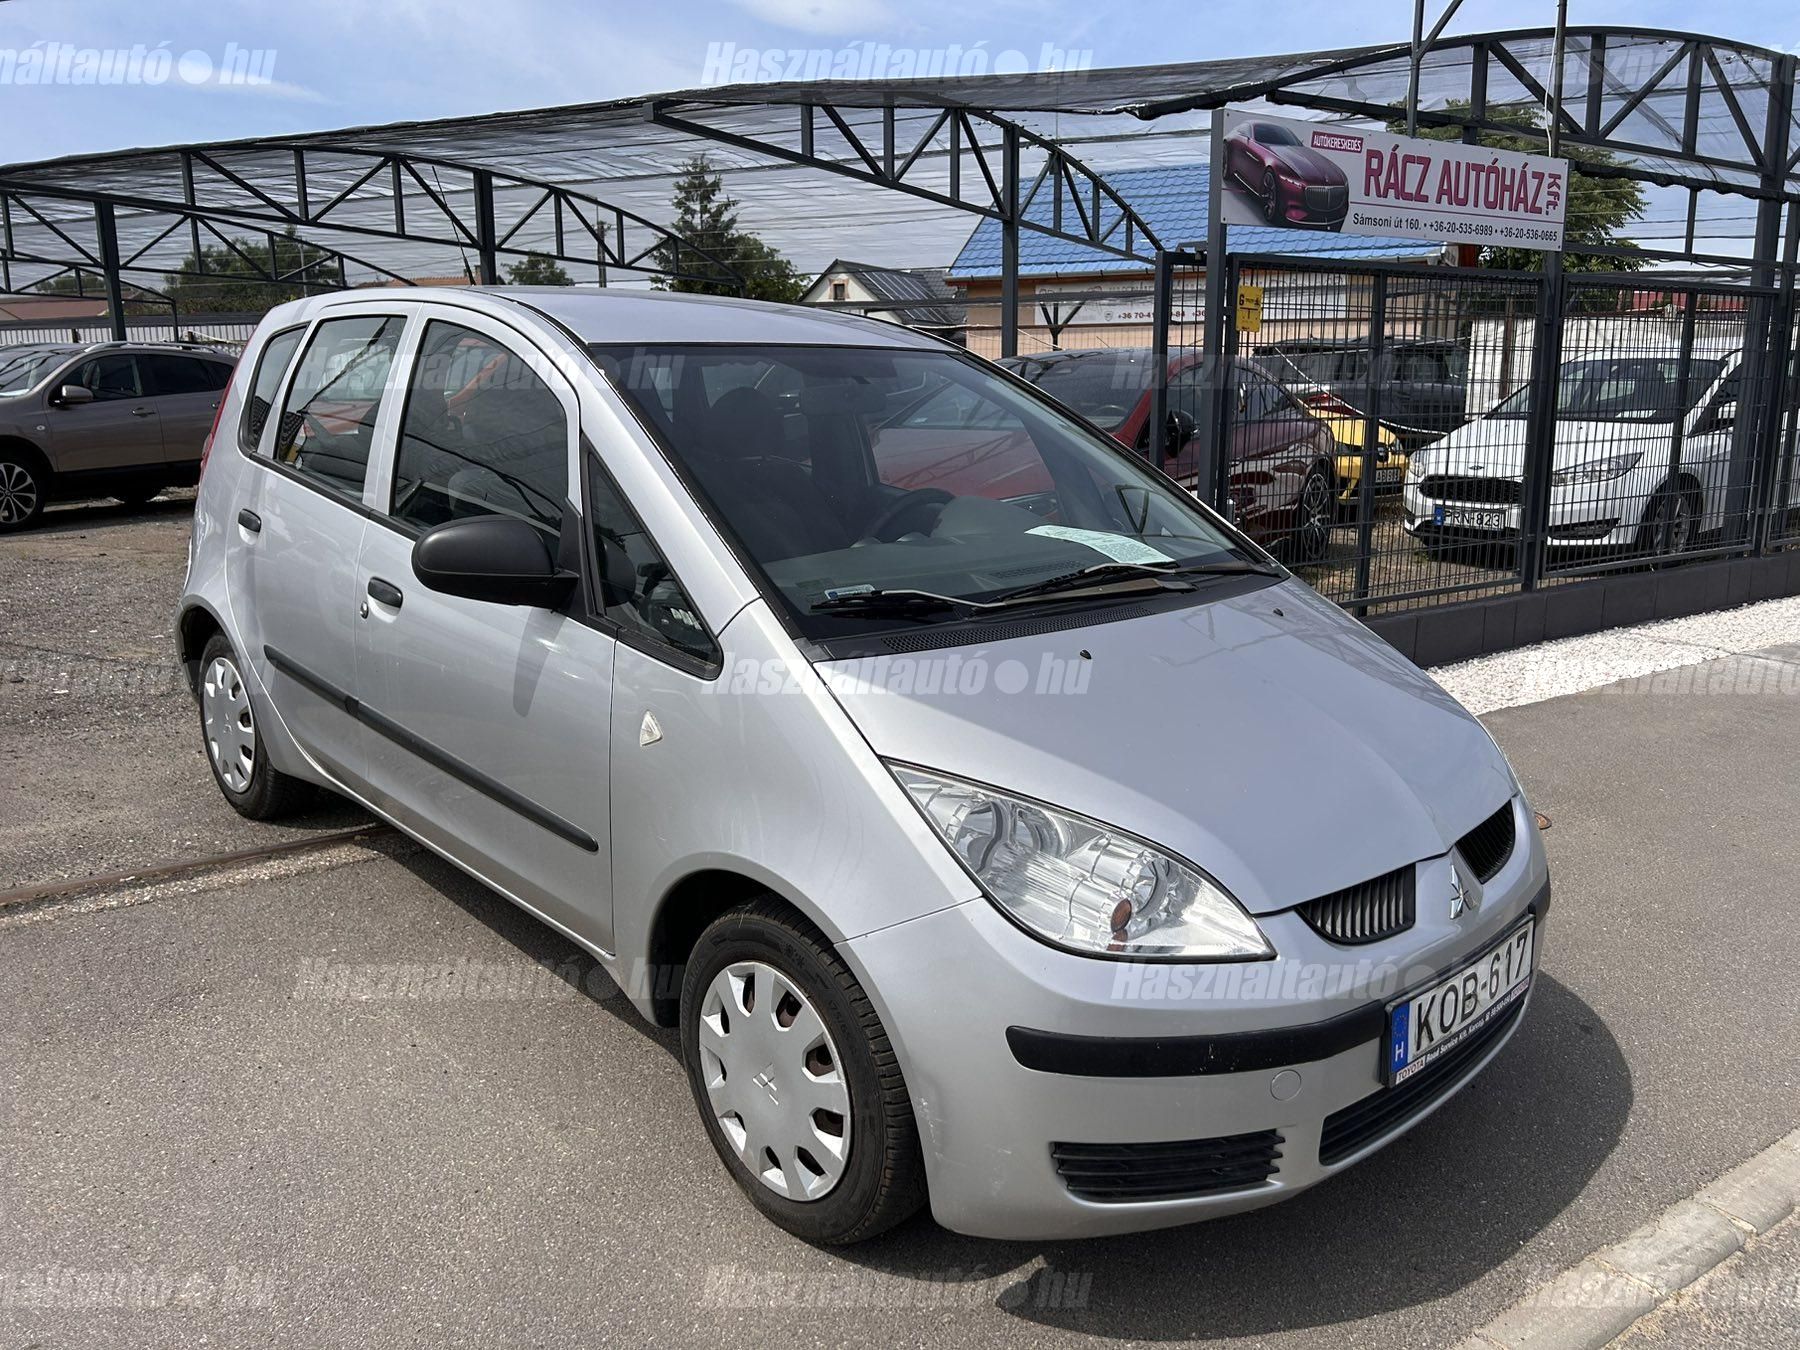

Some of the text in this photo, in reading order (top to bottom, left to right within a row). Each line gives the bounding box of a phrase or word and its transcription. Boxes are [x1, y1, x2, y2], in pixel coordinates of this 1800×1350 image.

[1313, 134, 1362, 152] AUTÓKERESKEDÉS
[1364, 143, 1546, 215] RÁCZ AUTÓHÁZ
[1546, 173, 1562, 216] Kft.
[1352, 213, 1558, 242] Sámsoni út 160. +36-20-535-6989 +36-20-536-0665
[1416, 929, 1529, 1052] KOB-617
[1394, 1041, 1405, 1062] H
[1398, 1058, 1425, 1083] TOYOTA
